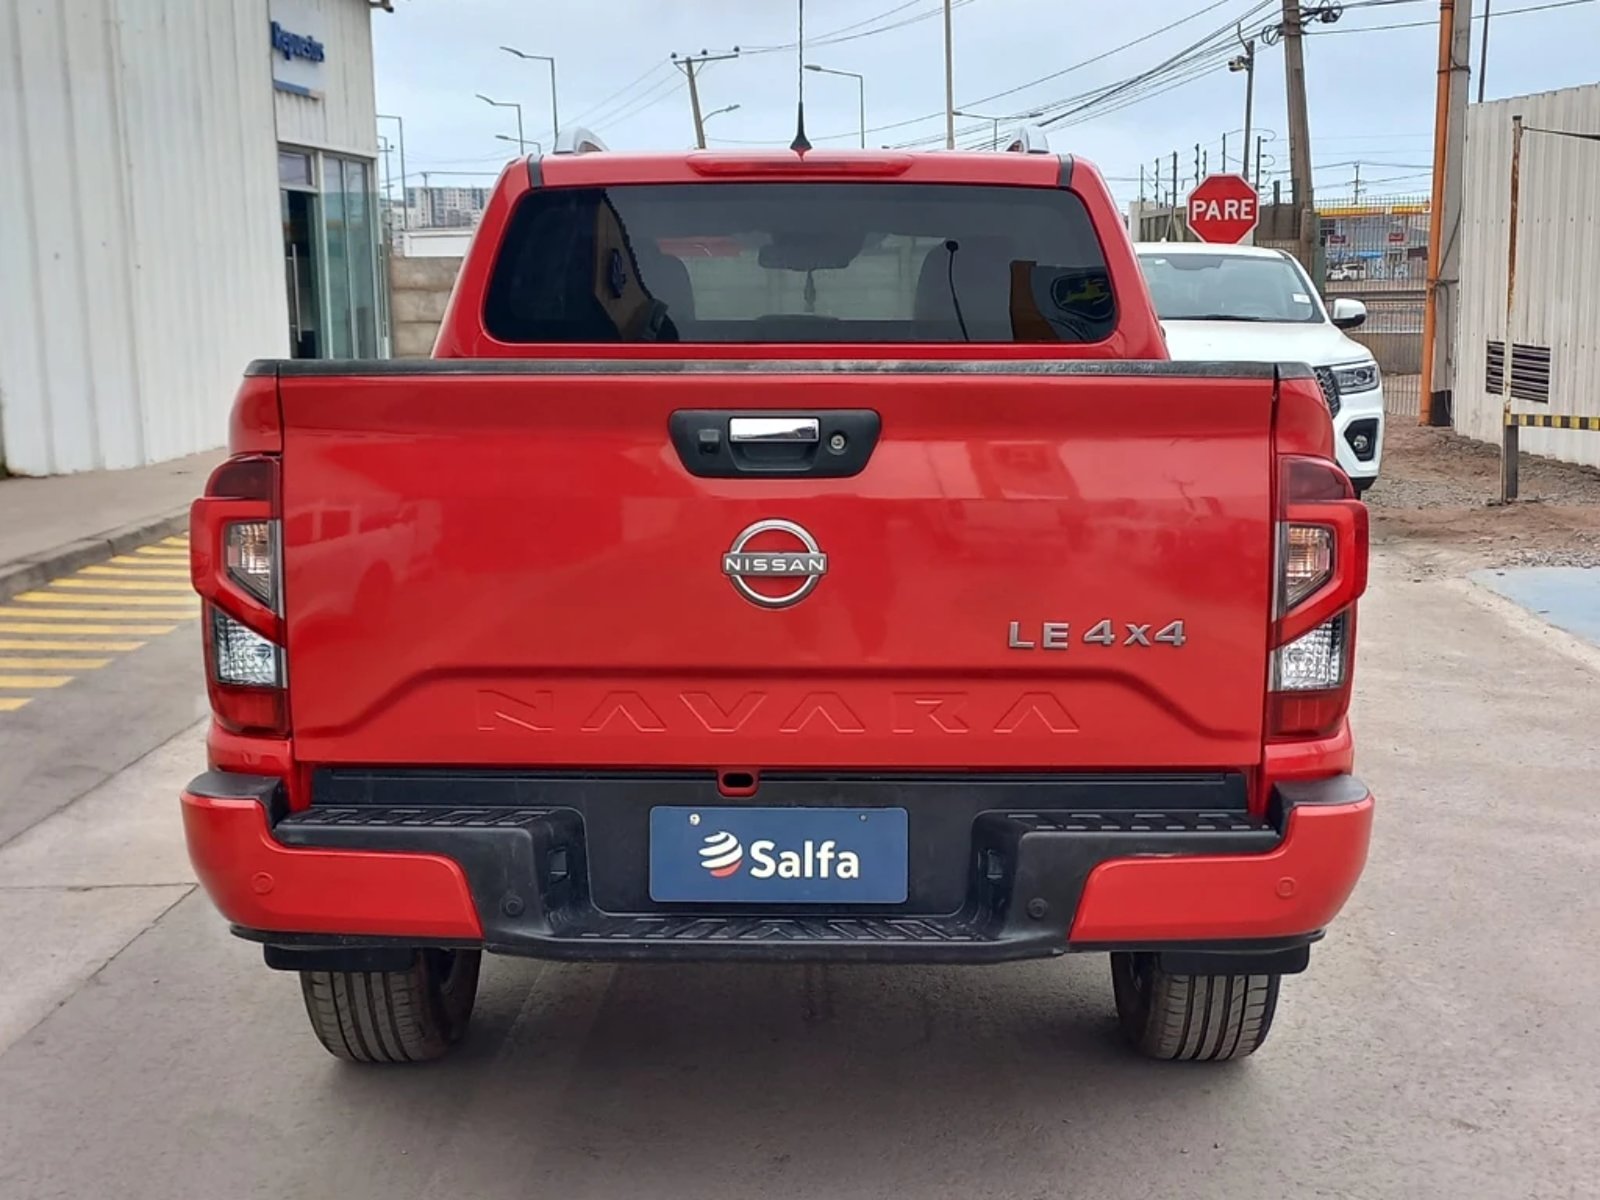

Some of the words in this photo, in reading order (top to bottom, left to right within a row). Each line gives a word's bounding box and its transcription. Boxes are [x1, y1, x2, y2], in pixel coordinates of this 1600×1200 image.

[1191, 199, 1254, 221] PARE
[725, 558, 825, 572] NISSAN
[1008, 621, 1070, 649] LE
[477, 690, 1080, 733] NAVARA
[750, 840, 859, 879] Salfa
